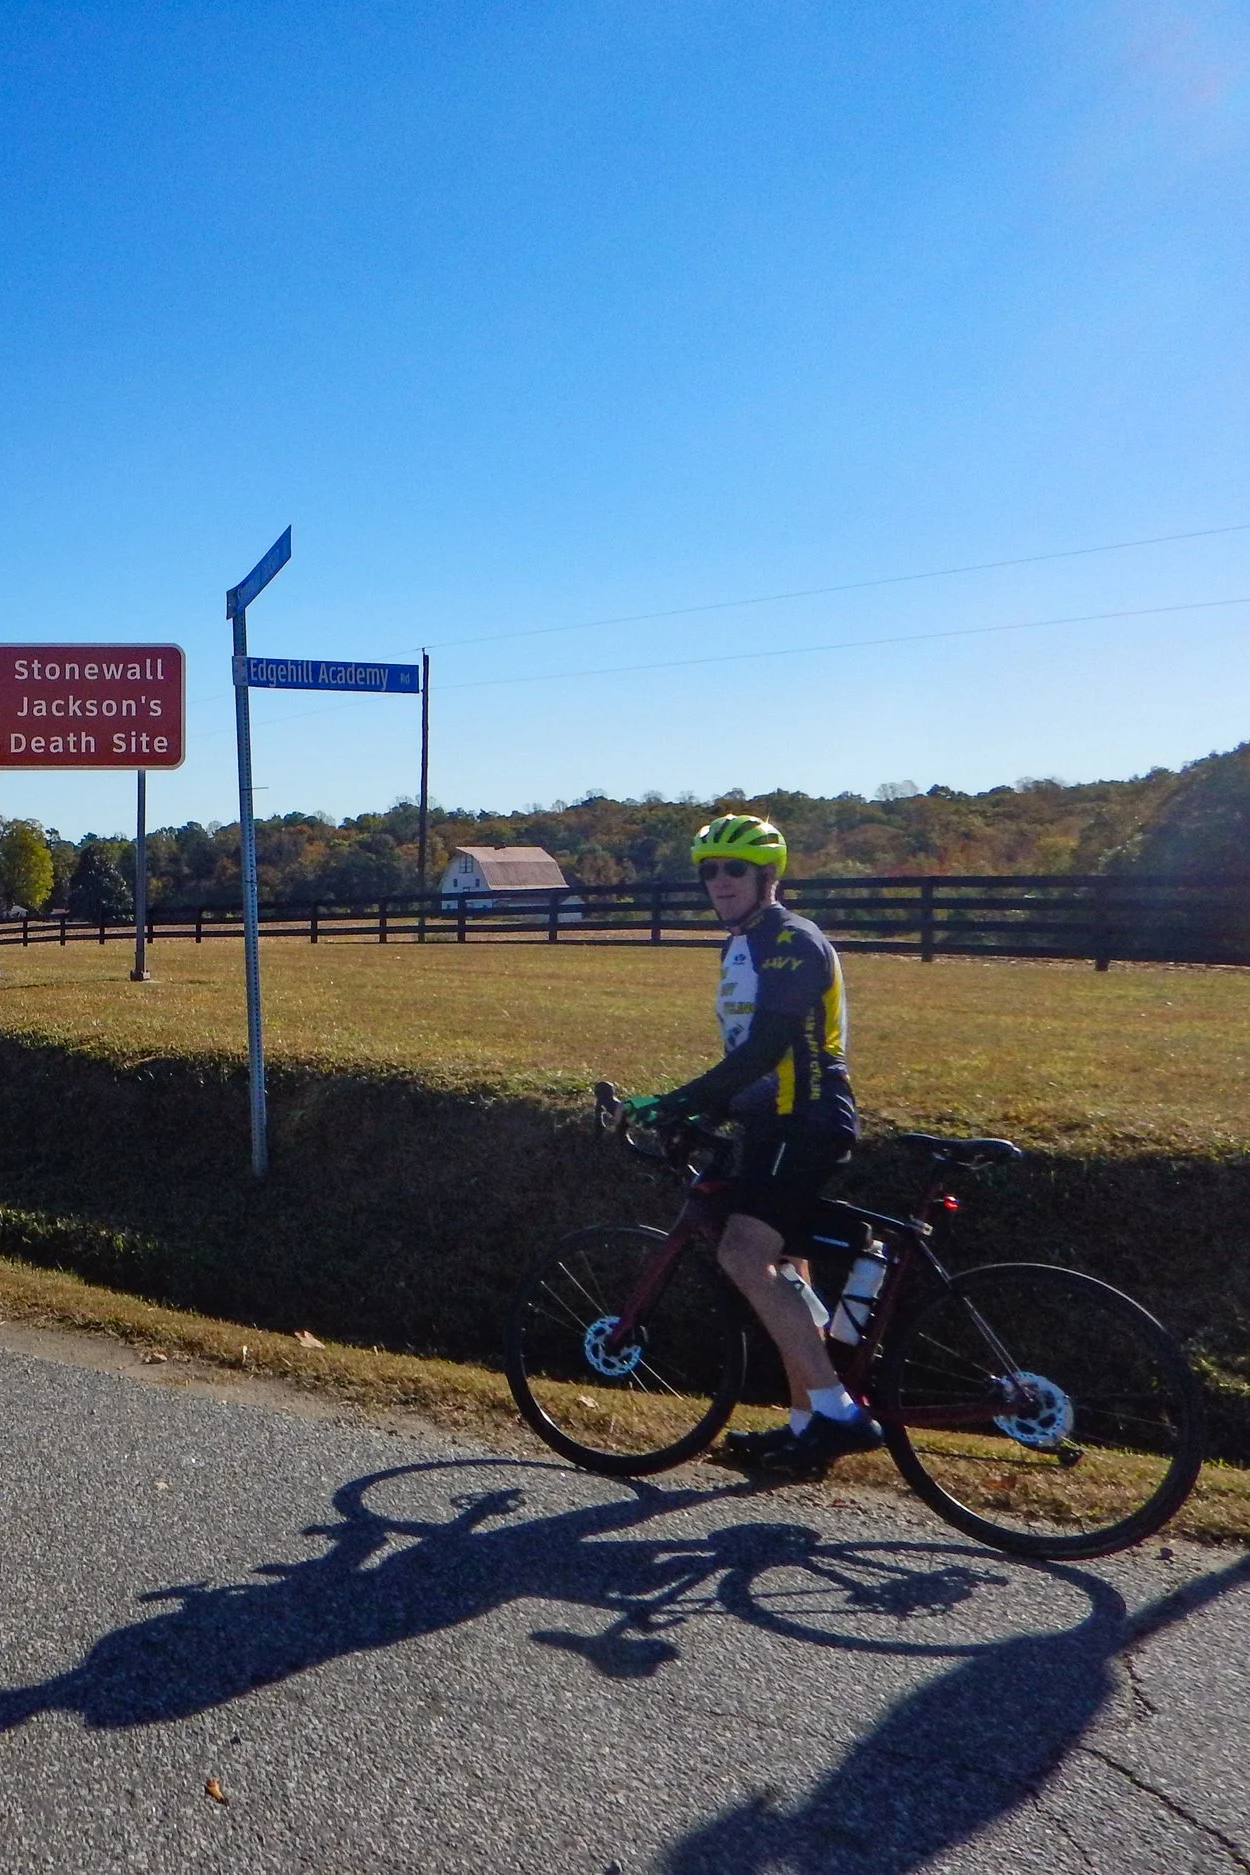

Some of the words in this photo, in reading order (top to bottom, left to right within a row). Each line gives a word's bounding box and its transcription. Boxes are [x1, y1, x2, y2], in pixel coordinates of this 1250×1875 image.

[14, 659, 165, 680] Stonewall
[250, 659, 314, 688] Edgehill
[318, 662, 389, 692] Academy
[17, 696, 162, 717] Jackson's
[10, 732, 96, 753] Death
[112, 731, 169, 753] Site
